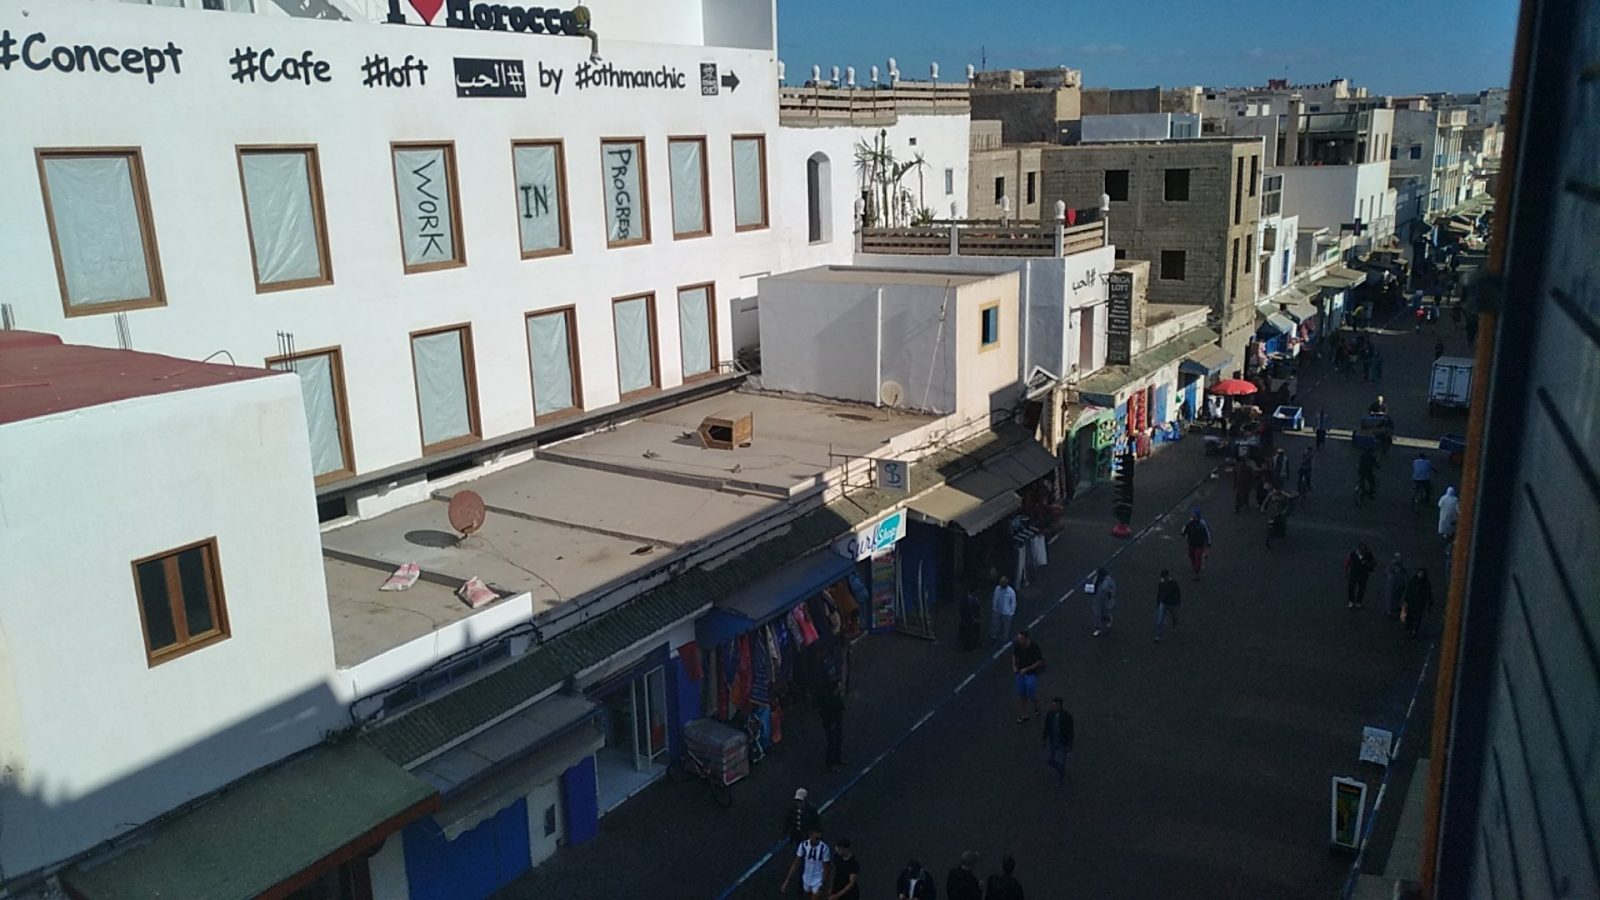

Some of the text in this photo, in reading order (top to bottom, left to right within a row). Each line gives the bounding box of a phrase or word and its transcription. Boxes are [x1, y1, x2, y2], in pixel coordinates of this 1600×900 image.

[230, 47, 332, 85] #Cafe
[360, 54, 429, 89] #loft
[538, 61, 564, 95] by
[575, 61, 686, 90] #othmanchic
[412, 159, 444, 257] WORK
[520, 183, 549, 219] IN
